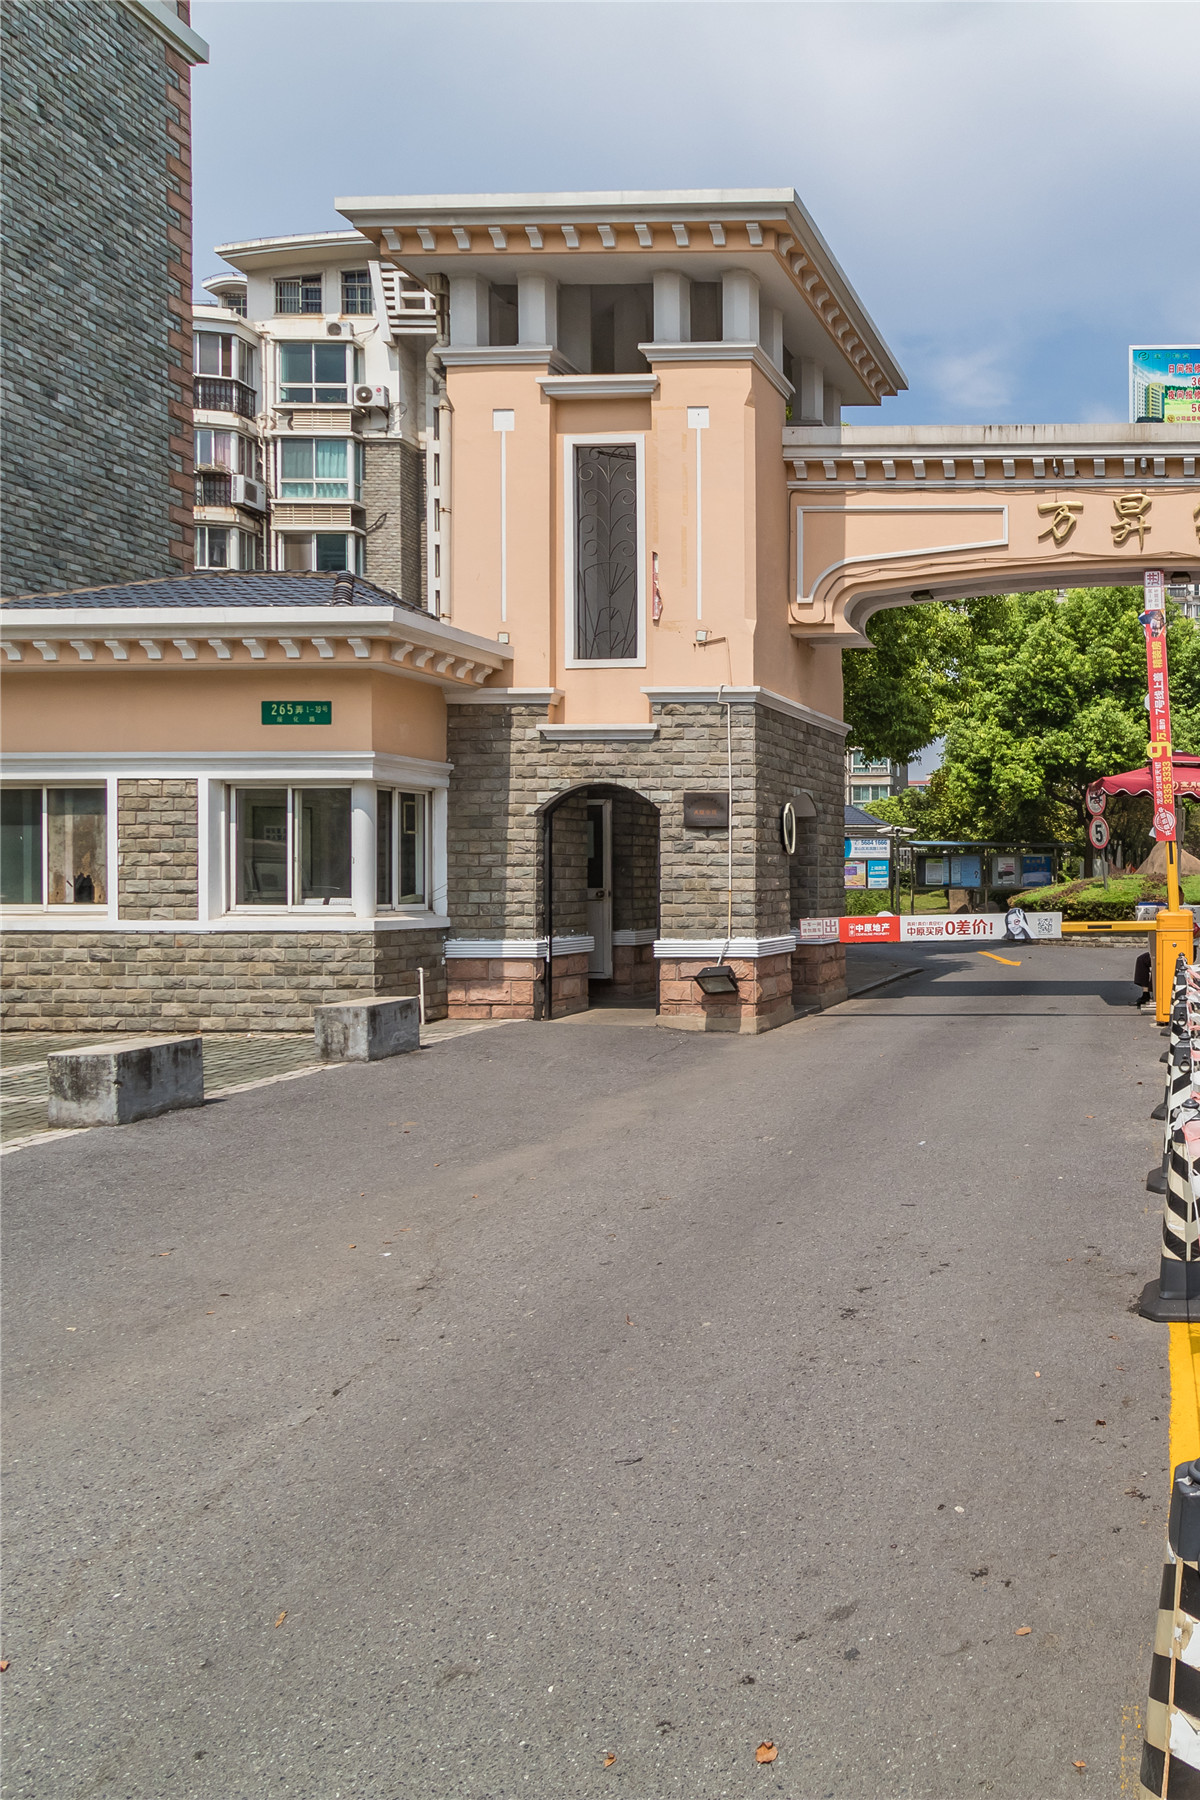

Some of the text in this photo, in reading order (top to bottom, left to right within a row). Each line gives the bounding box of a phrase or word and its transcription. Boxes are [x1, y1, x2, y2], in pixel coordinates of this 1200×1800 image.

[1146, 572, 1160, 586] 进
[1152, 641, 1163, 669] 精装房
[1153, 672, 1165, 716] 7号线上盖
[1162, 761, 1173, 805] 3335 3333
[1095, 824, 1103, 843] 5
[825, 920, 837, 933] 出
[855, 923, 890, 932] 中原地产
[906, 926, 944, 936] 中原买房
